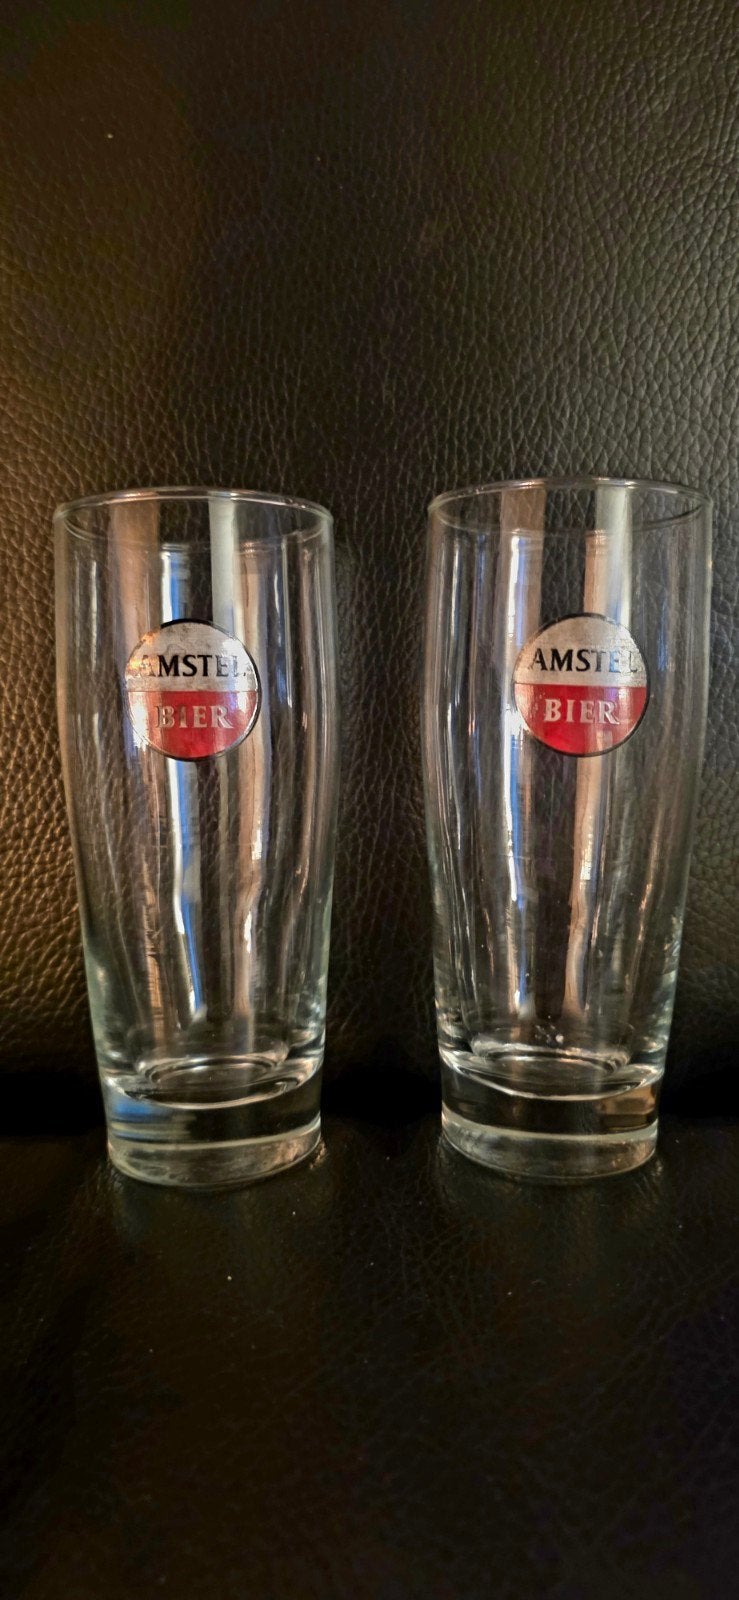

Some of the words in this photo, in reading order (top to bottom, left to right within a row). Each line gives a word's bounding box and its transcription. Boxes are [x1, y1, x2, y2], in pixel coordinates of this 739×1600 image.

[528, 648, 638, 673] AMSTEL
[155, 704, 234, 729] BIER
[543, 698, 620, 725] BIER
